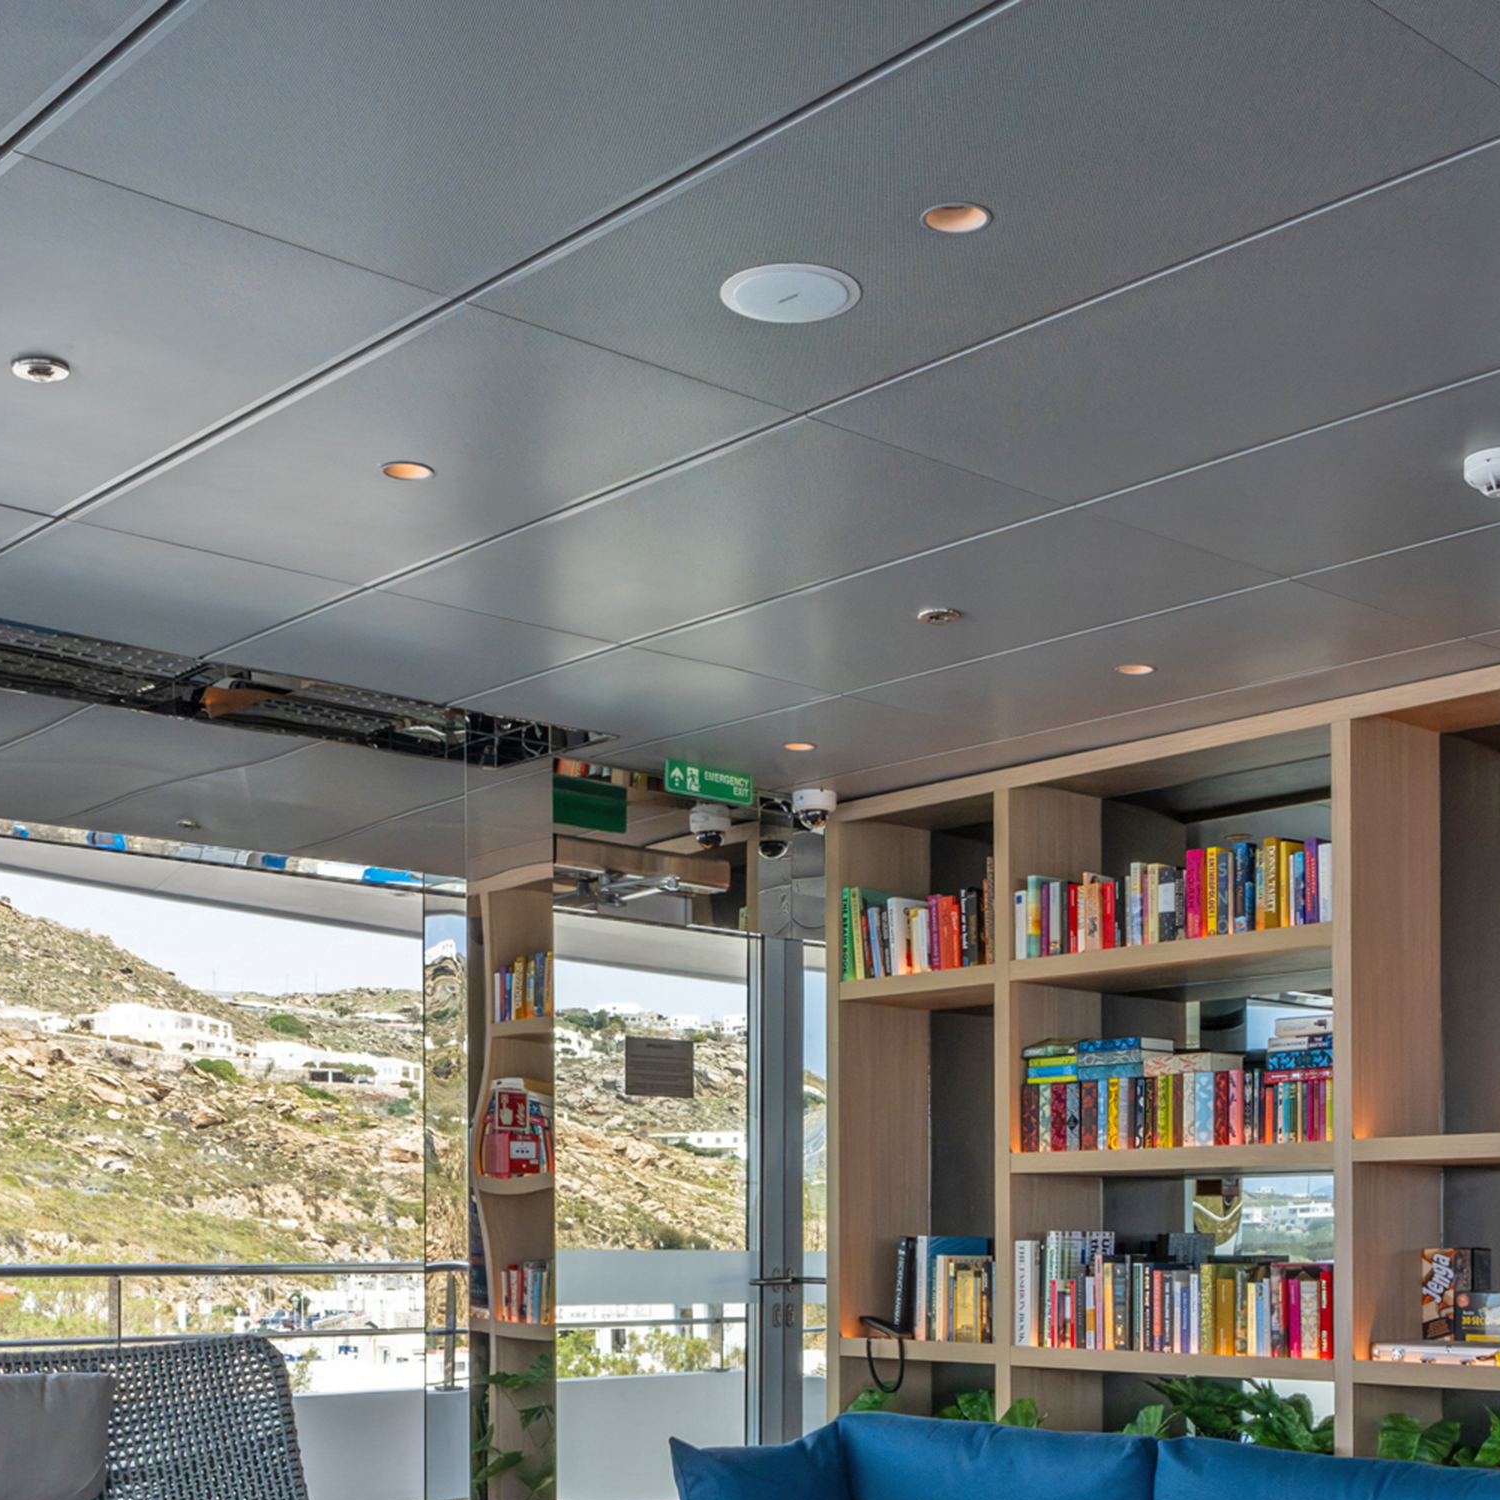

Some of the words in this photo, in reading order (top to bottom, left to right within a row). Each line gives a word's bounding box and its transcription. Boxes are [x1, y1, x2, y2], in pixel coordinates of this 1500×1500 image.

[704, 770, 749, 789] EMERGENCY
[733, 786, 749, 798] EXIT
[1267, 845, 1276, 879] DONNA
[1267, 880, 1276, 914] TARTT
[896, 1261, 905, 1293] SCIENCE
[1422, 1253, 1455, 1304] Jenga
